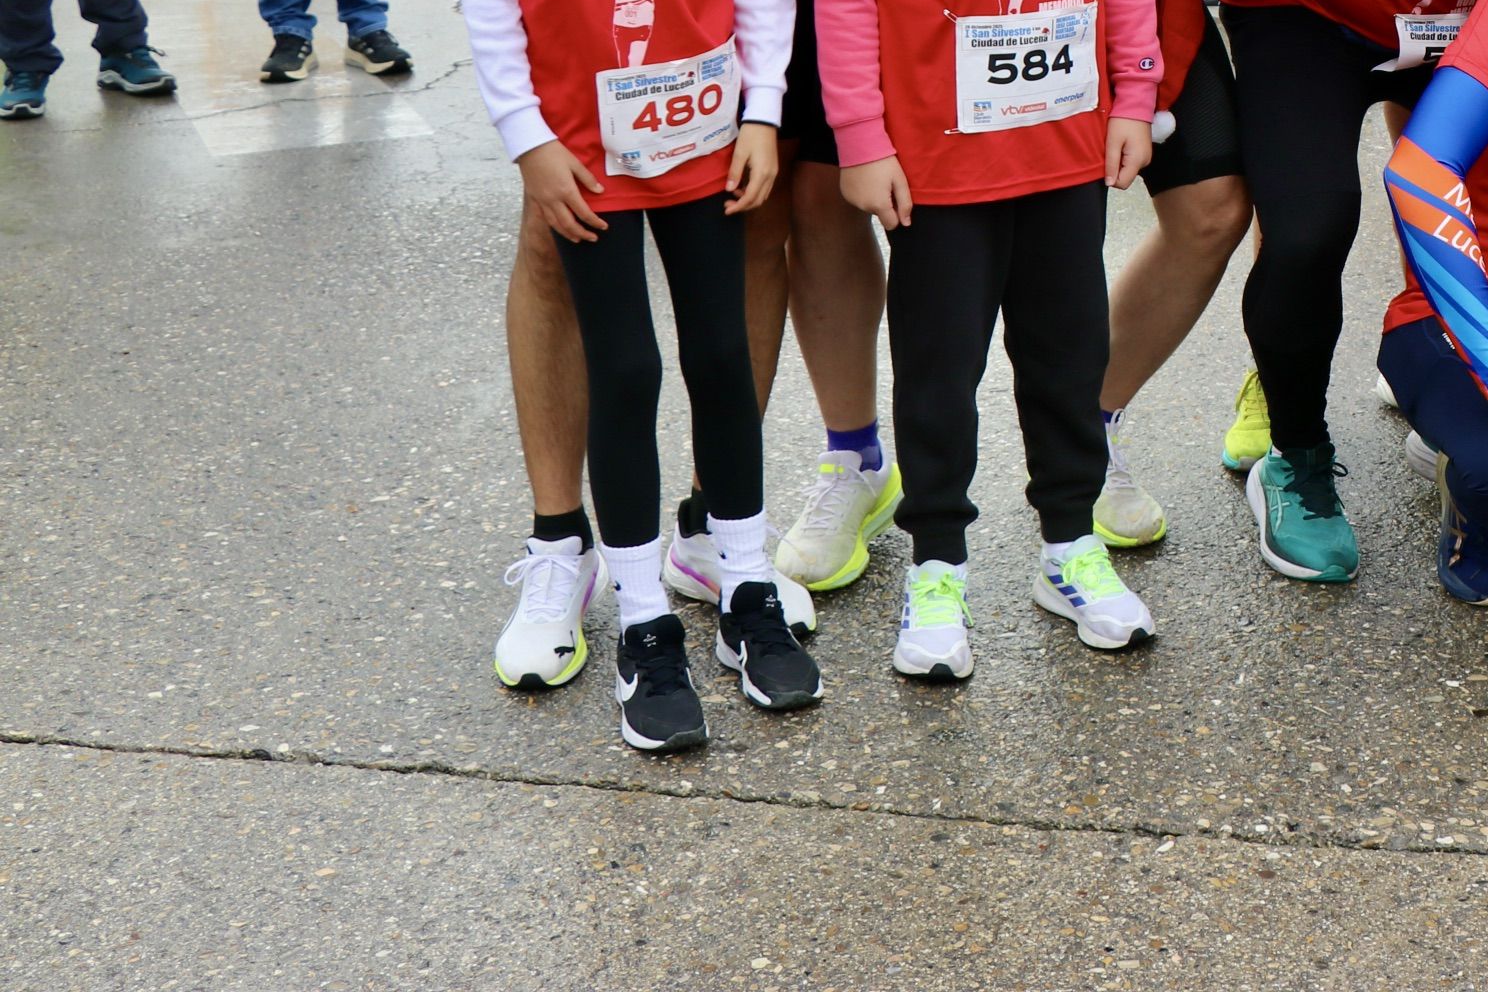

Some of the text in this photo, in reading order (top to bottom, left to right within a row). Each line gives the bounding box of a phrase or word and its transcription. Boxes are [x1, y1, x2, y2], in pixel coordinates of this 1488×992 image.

[972, 28, 990, 38] San
[992, 26, 1032, 37] Silvestre
[1409, 24, 1424, 32] San
[1425, 24, 1460, 33] Silvestre
[971, 35, 1048, 48] Ciudad de Lucena
[1410, 32, 1448, 41] Ciudad de
[987, 44, 1073, 85] 584
[615, 78, 633, 91] San
[635, 74, 678, 88] Silvestre
[616, 79, 695, 101] Ciudad de Lucena
[632, 83, 723, 133] 480
